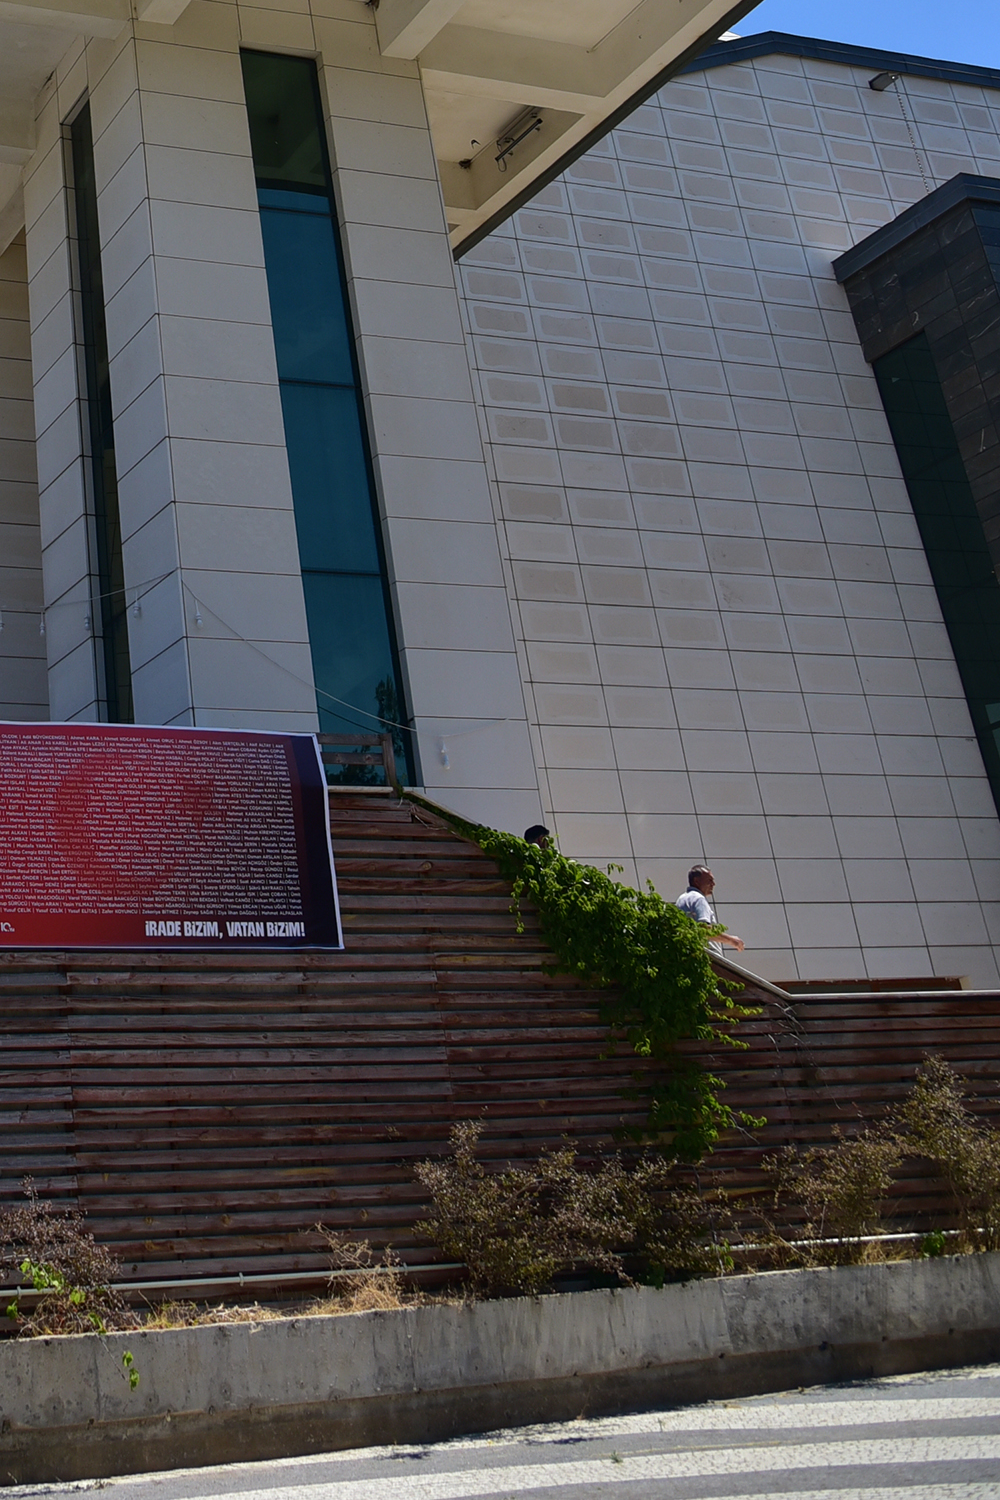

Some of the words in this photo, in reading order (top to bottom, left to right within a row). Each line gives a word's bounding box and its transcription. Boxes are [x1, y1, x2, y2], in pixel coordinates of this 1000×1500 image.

[145, 921, 181, 937] İRADE
[226, 922, 264, 937] VATAN
[266, 921, 306, 937] BİZİM!
